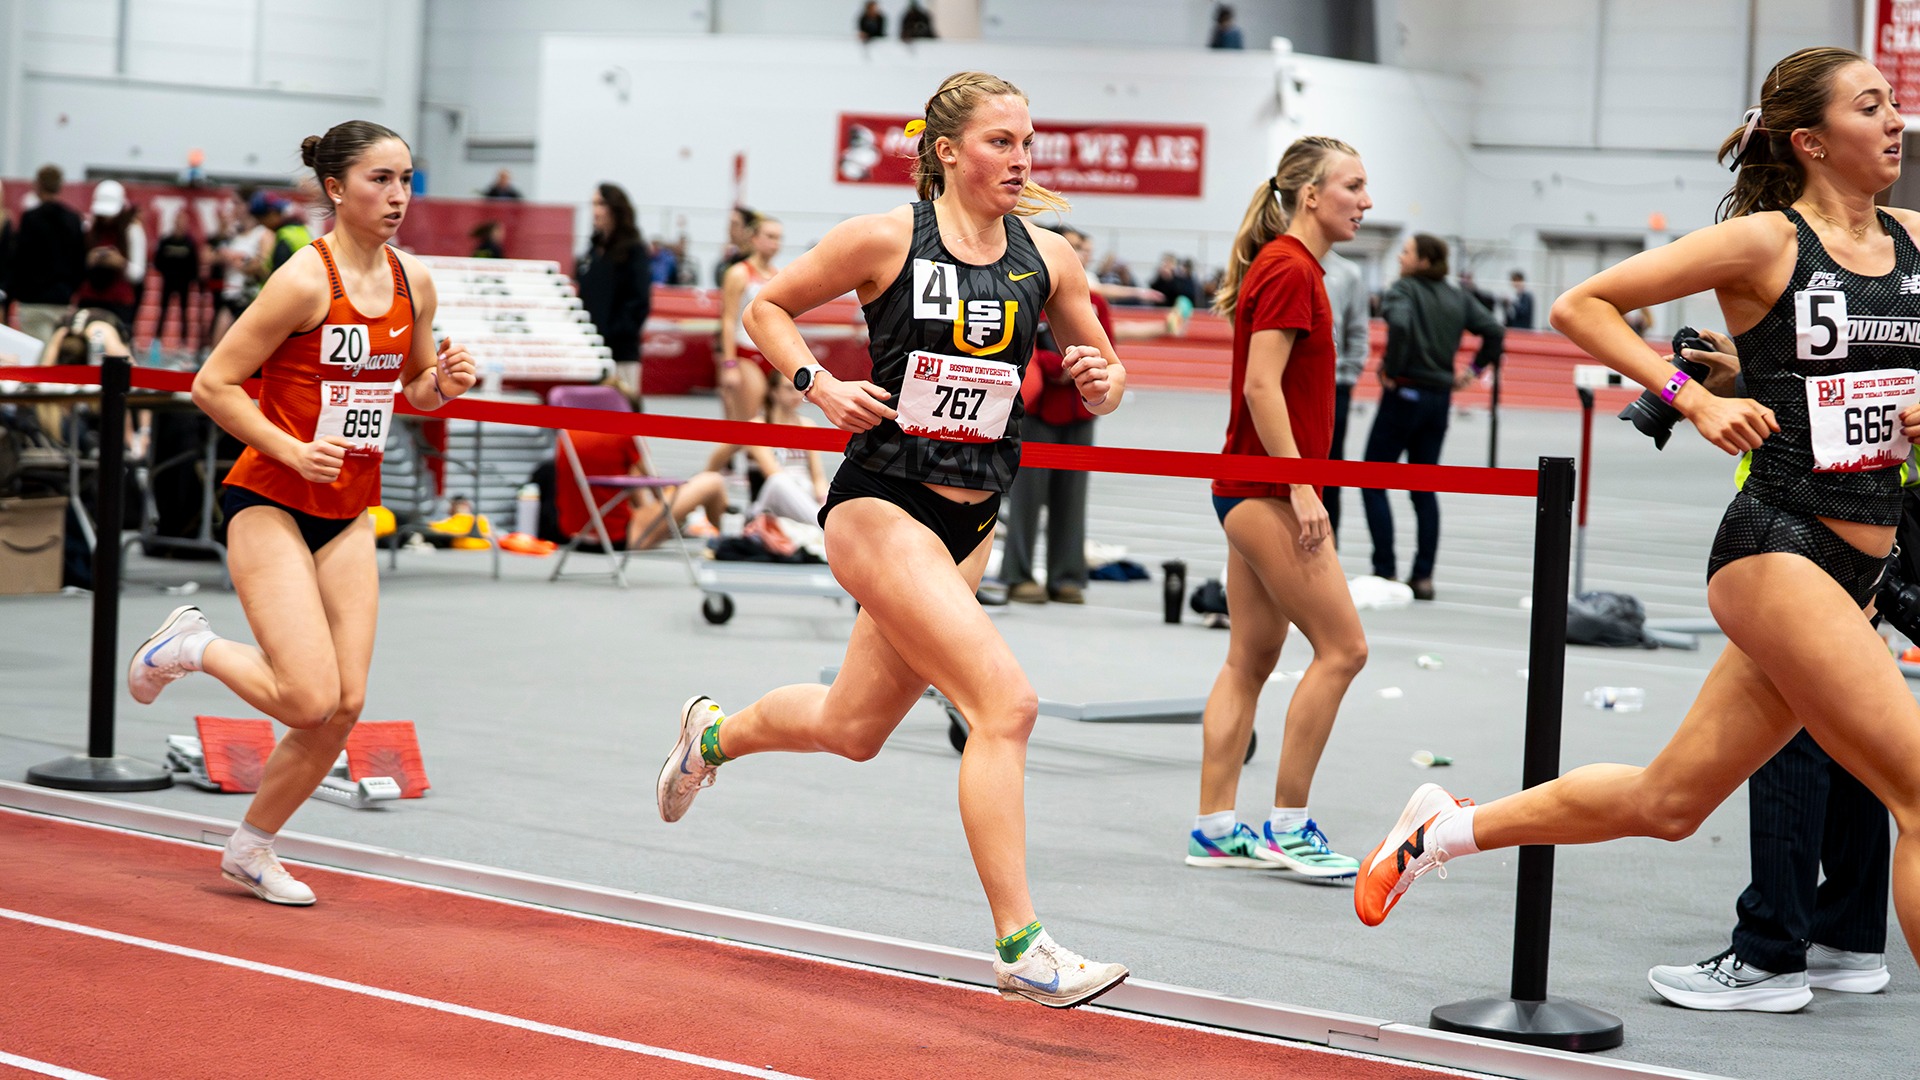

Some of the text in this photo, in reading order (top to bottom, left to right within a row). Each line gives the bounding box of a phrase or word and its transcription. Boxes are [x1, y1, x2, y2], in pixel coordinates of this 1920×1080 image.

[1073, 133, 1129, 169] WE
[1132, 135, 1200, 171] ARE
[1806, 280, 1843, 288] EAST
[1811, 271, 1836, 280] BIG
[922, 266, 952, 315] 4
[1810, 295, 1838, 356] 5
[1848, 319, 1920, 344] OVIDEN
[329, 327, 363, 363] 20
[915, 355, 943, 378] BU
[949, 363, 1011, 378] BOSTON UNIVERSITY
[330, 385, 350, 404] BU
[932, 385, 987, 421] 767
[1817, 378, 1845, 402] BU
[343, 409, 382, 438] 899
[1845, 404, 1896, 446] 665
